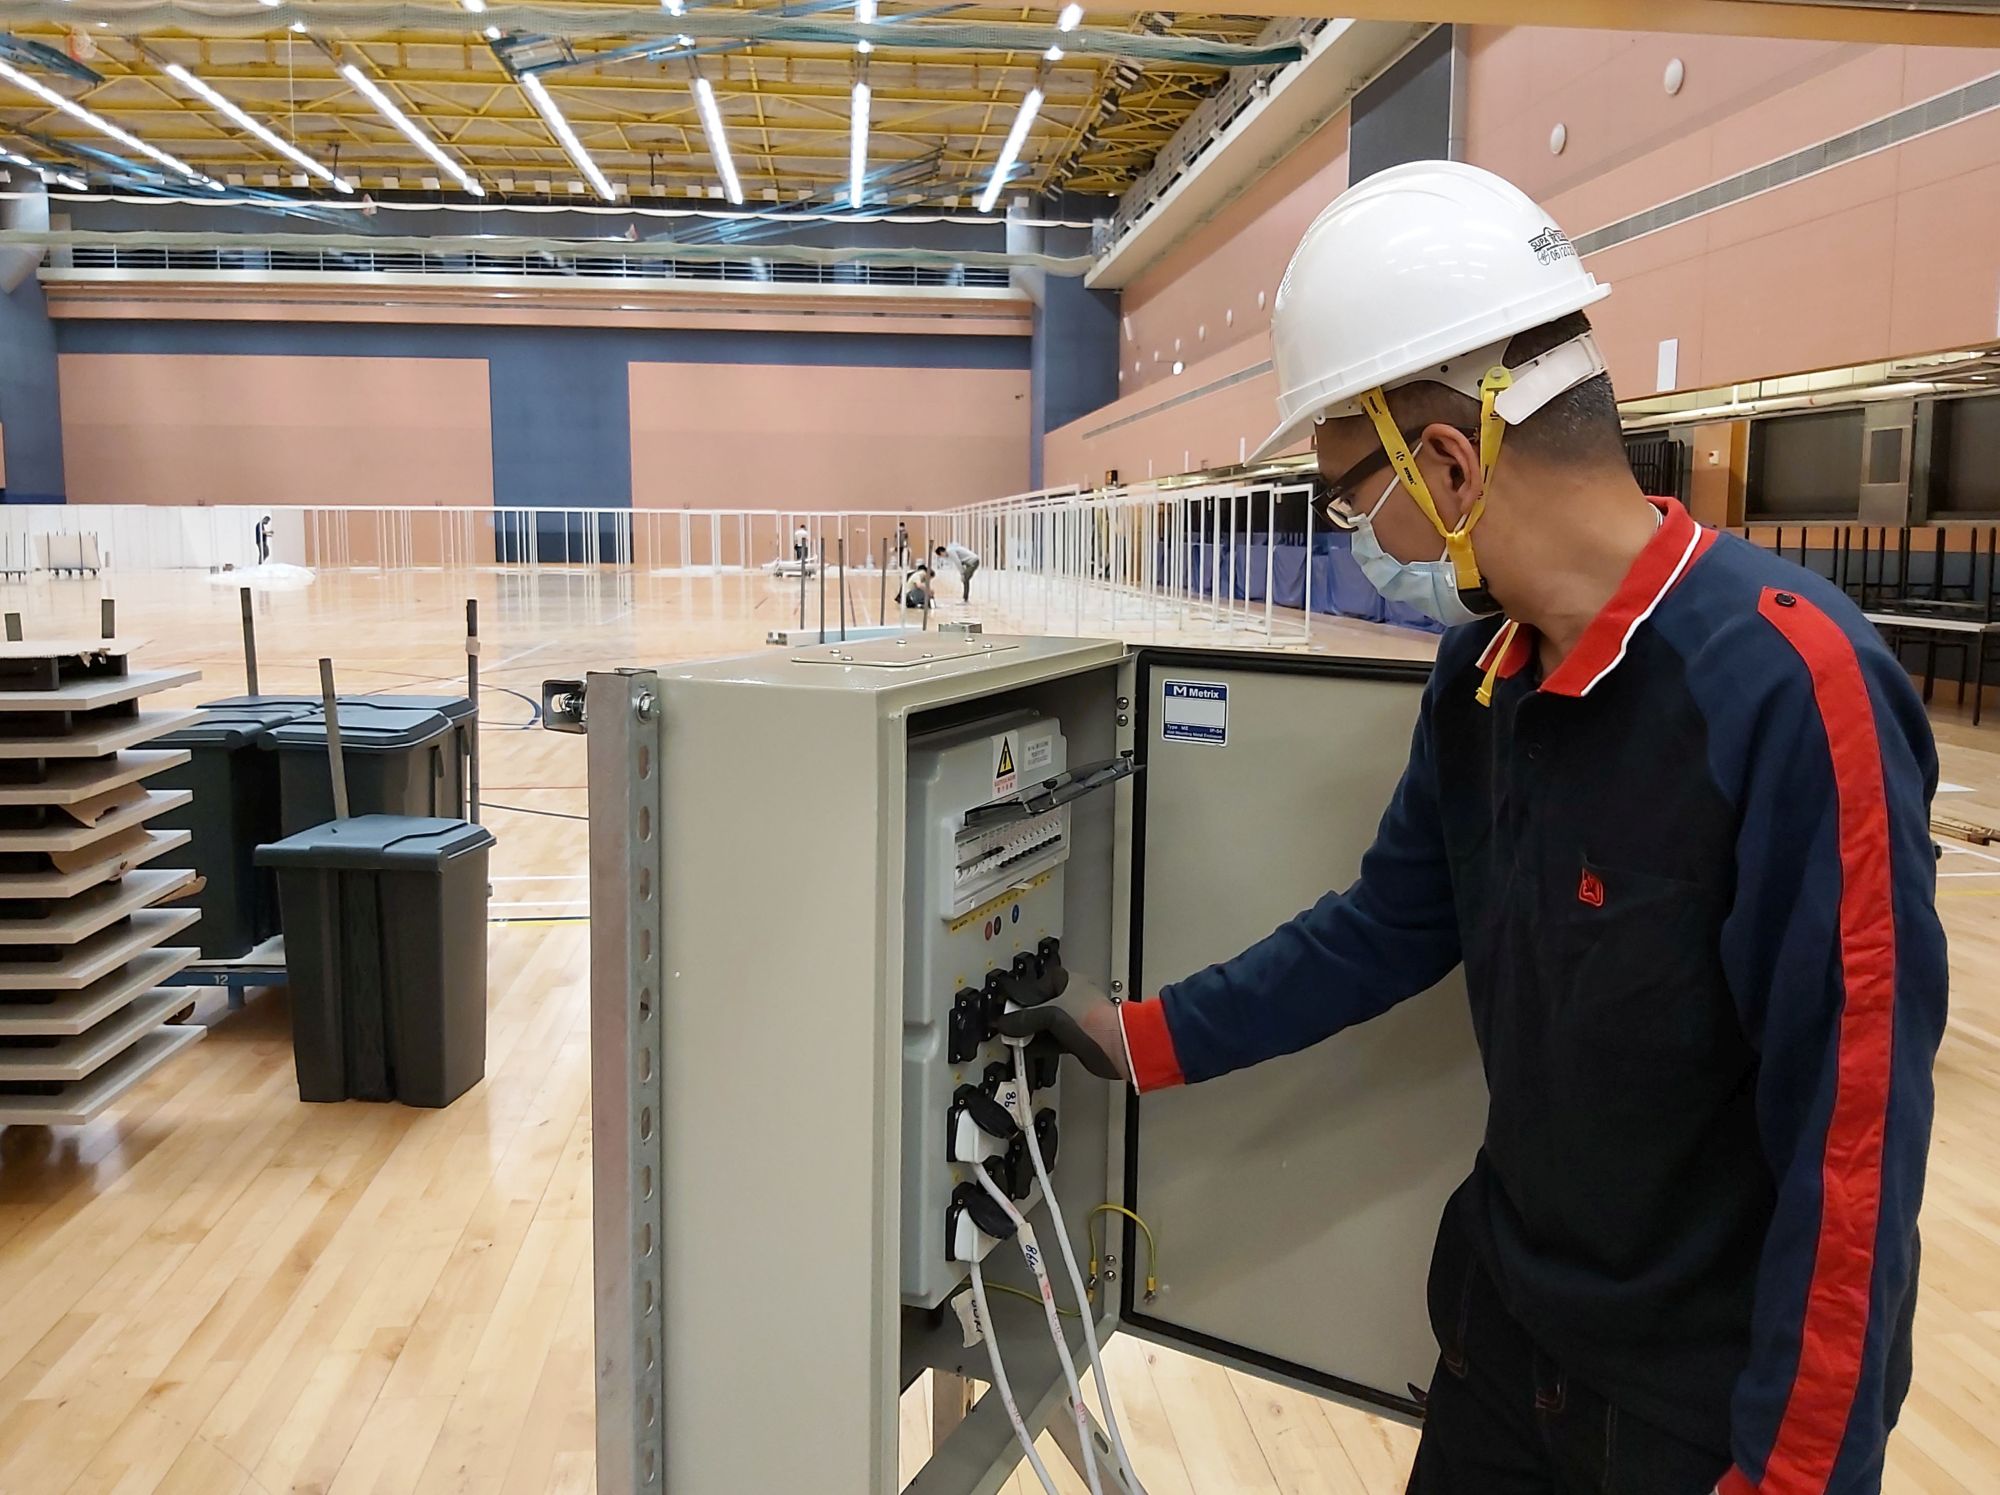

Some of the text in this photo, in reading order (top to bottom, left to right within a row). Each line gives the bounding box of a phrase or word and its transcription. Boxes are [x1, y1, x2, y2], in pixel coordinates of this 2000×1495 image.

[1530, 236, 1550, 250] SUPA
[1188, 687, 1220, 699] Metrix
[213, 974, 229, 985] 12
